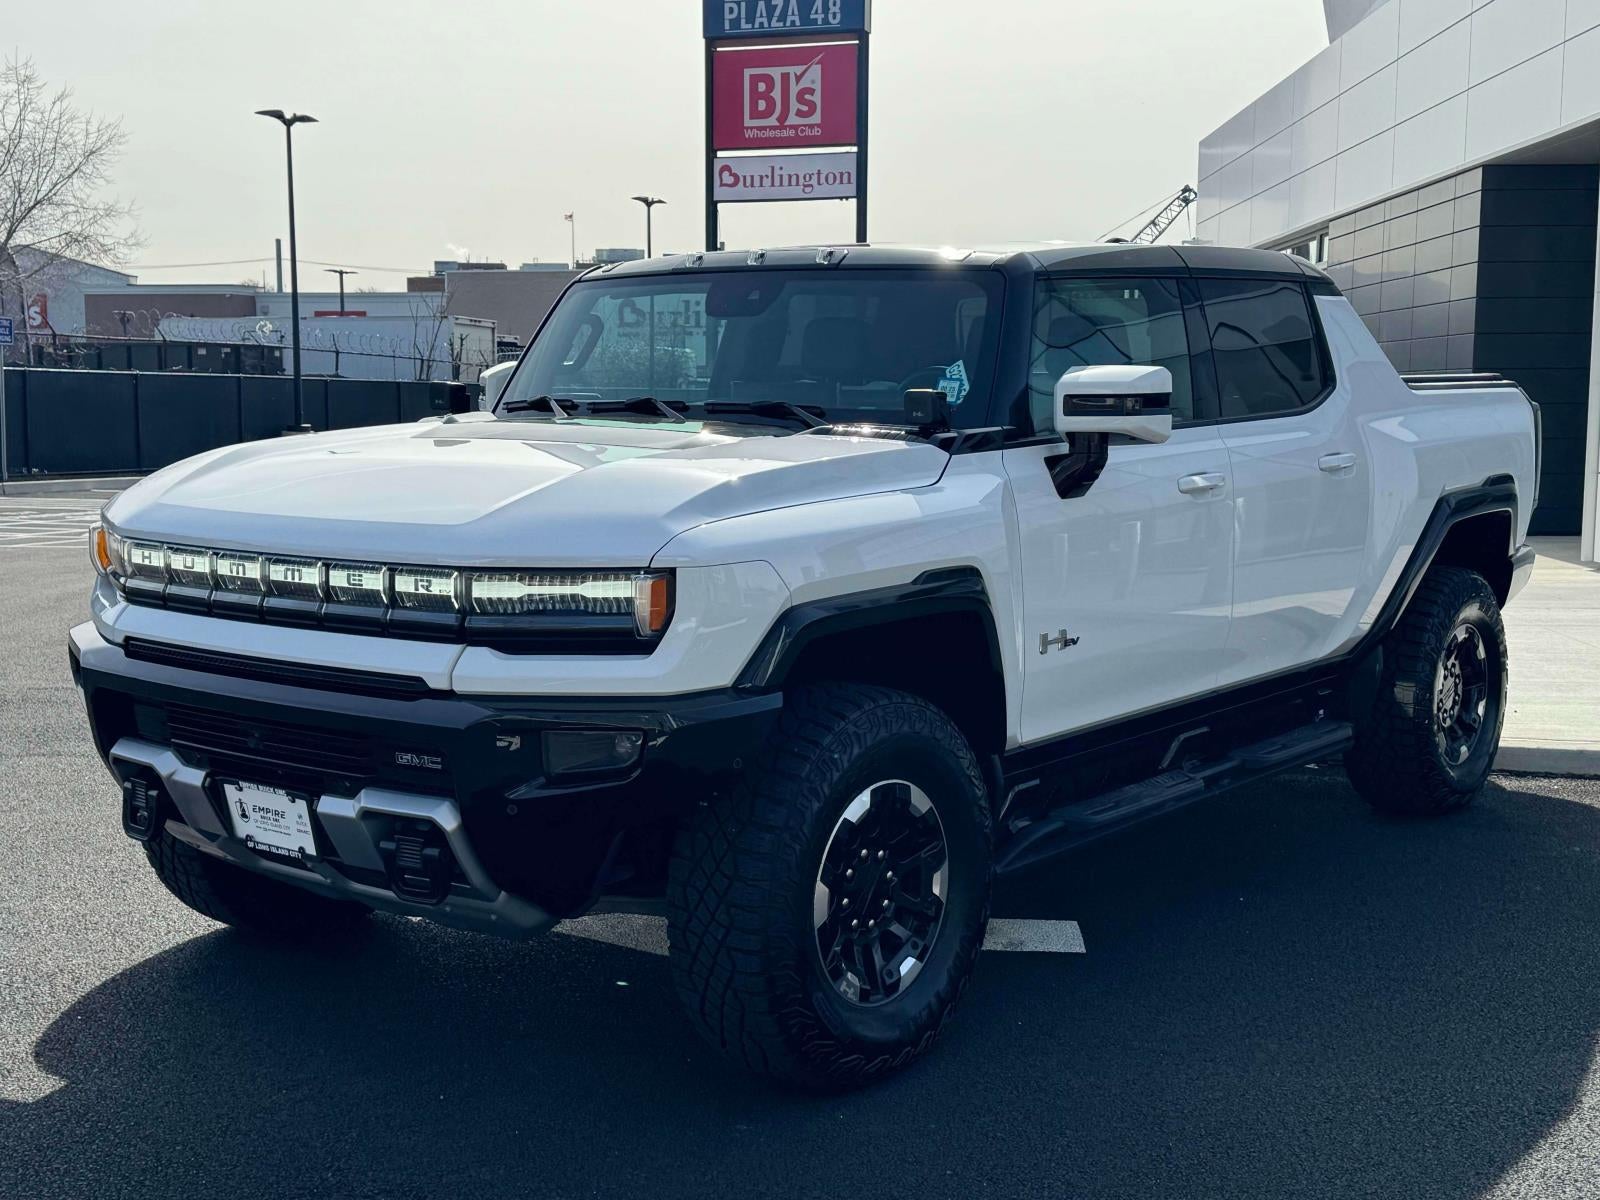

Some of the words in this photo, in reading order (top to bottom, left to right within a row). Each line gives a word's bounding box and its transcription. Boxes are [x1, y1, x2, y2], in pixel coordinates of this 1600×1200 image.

[724, 0, 800, 30] PLAZA
[810, 0, 841, 25] 48
[744, 128, 795, 139] Wholesale
[798, 126, 822, 136] Club
[718, 164, 854, 194] Burlington
[142, 551, 432, 593] HUMMER
[395, 752, 442, 769] GMC
[253, 804, 286, 819] EMPIRE
